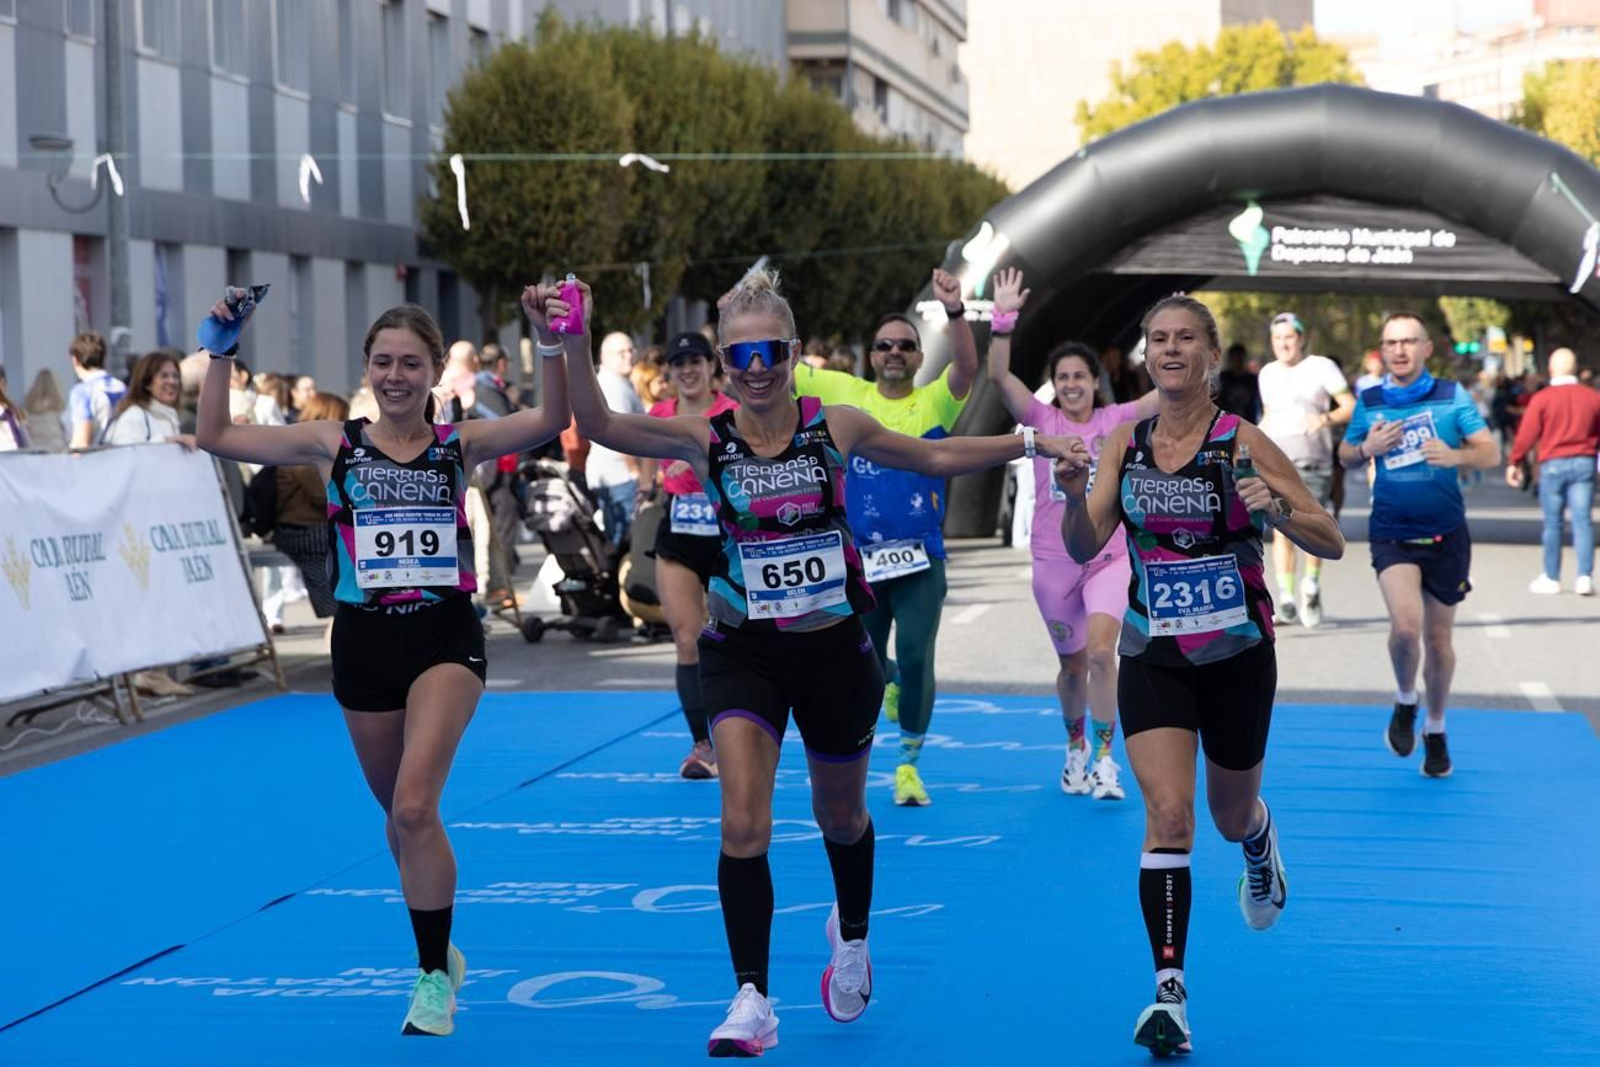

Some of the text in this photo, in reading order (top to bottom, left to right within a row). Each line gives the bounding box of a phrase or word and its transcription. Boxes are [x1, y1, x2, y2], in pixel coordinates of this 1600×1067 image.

[351, 482, 451, 502] CANENA
[728, 466, 827, 498] CANENA
[1123, 493, 1221, 513] CANENA
[374, 529, 440, 557] 919
[762, 556, 826, 589] 650
[876, 550, 914, 567] 400
[1153, 575, 1237, 608] 2316
